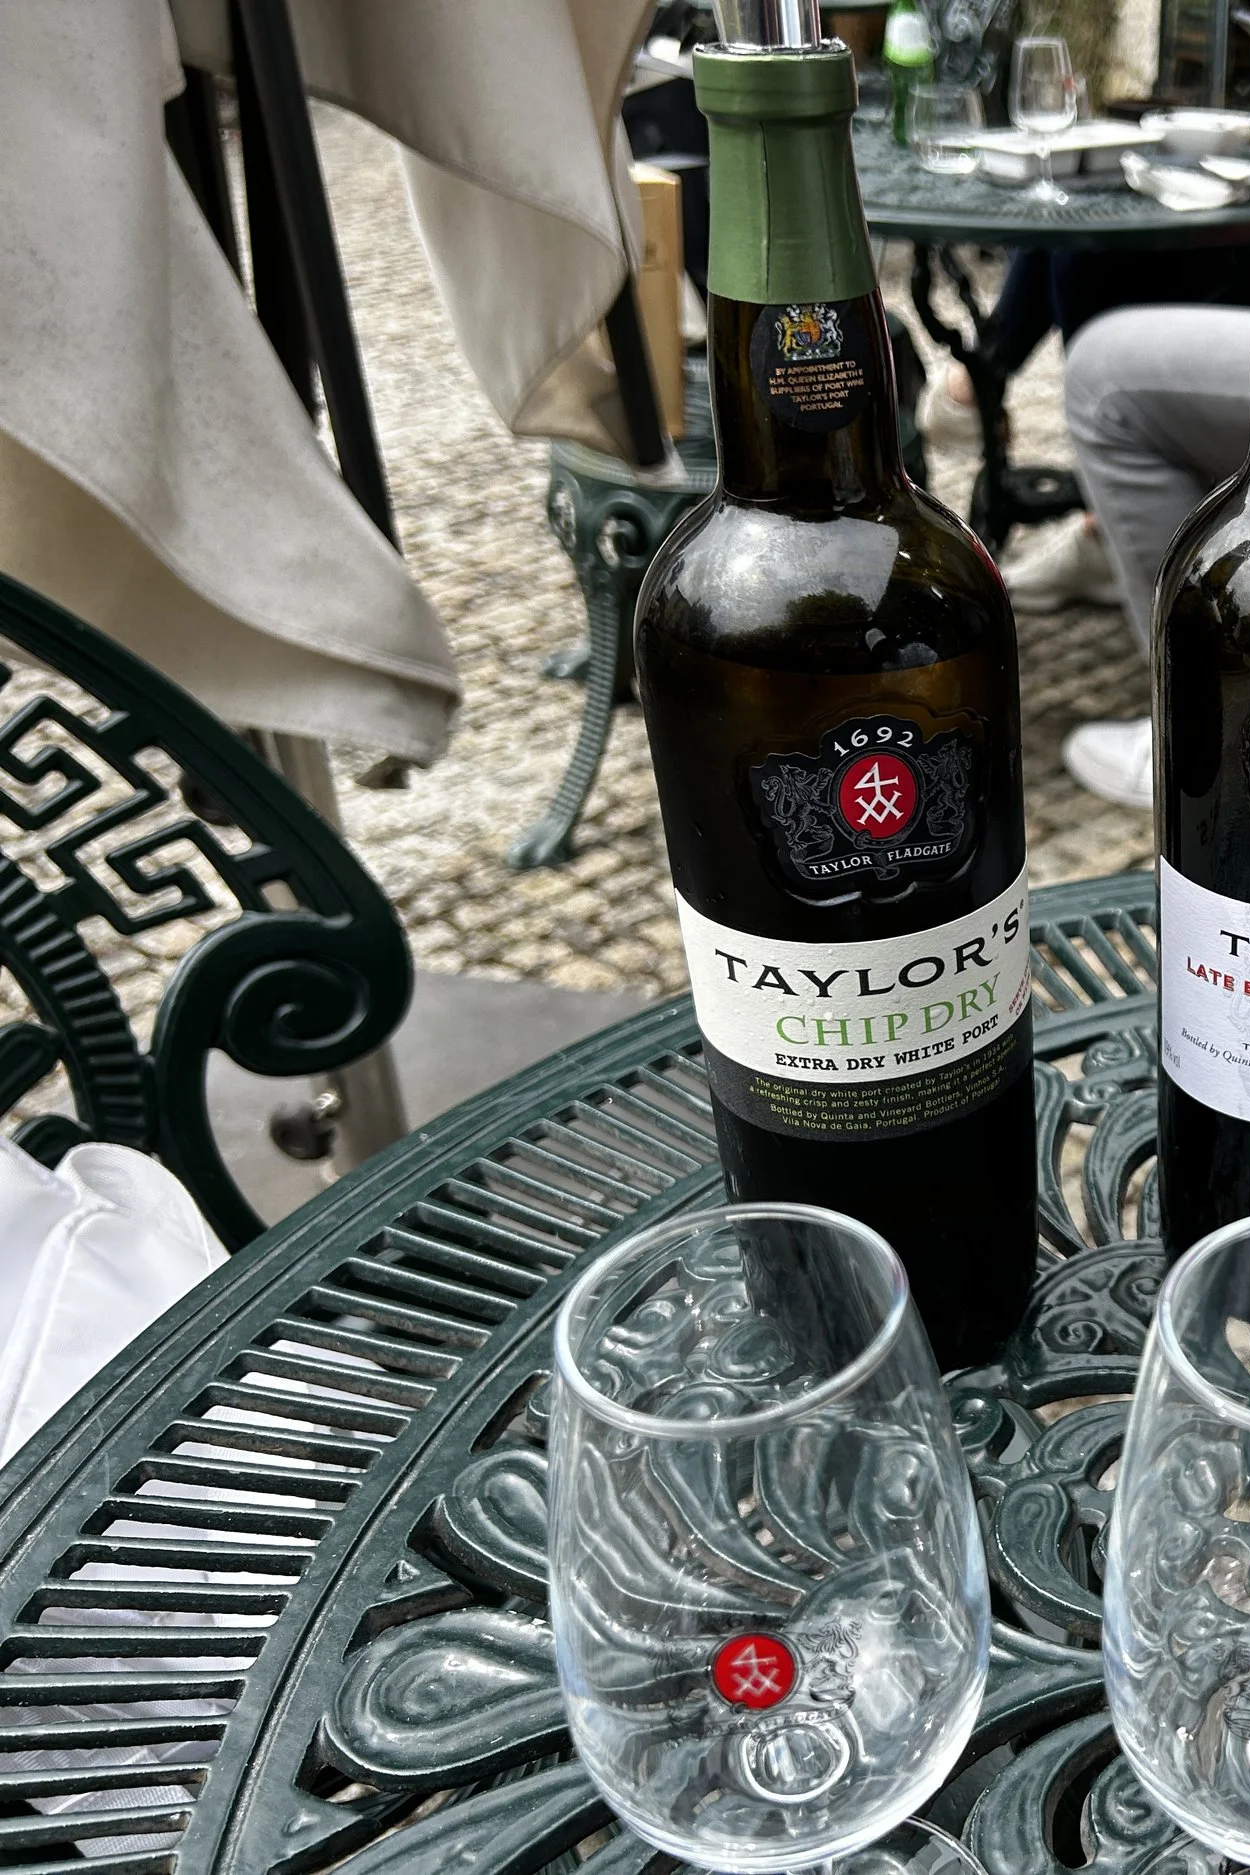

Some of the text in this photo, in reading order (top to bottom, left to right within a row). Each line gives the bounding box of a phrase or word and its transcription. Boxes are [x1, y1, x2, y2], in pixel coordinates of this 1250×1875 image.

[787, 361, 844, 375] APPOINTMENT
[845, 360, 856, 368] TO
[788, 373, 816, 384] QUEEN
[817, 369, 857, 382] ELIZABETH
[792, 390, 849, 403] TAYLOR'S PORT
[812, 383, 823, 391] OF
[824, 381, 845, 390] PORT
[847, 379, 864, 388] WINE
[800, 401, 844, 412] PORTUGAL
[833, 726, 914, 757] 1692
[809, 842, 952, 875] TAYLOR FLADGATE
[714, 908, 1020, 998] TAYLOR'S
[1187, 956, 1235, 992] LATE
[776, 1012, 909, 1047] CHIP
[920, 971, 1001, 1035] DRY
[775, 1014, 999, 1071] EXTRA DRY WHITE PORT
[1181, 1027, 1208, 1050] Bottled
[1209, 1044, 1220, 1058] by
[755, 1077, 770, 1088] The
[773, 1084, 808, 1095] original
[811, 1089, 827, 1098] dry
[830, 1089, 858, 1098] white
[861, 1088, 882, 1099] port
[885, 1080, 922, 1094] created
[925, 1076, 936, 1086] by
[940, 1063, 971, 1080] Taylor's
[757, 1086, 801, 1105] refreshing
[803, 1098, 828, 1108] crisp
[853, 1098, 879, 1108] zesty
[918, 1081, 951, 1097] making
[953, 1077, 961, 1086] it
[770, 1103, 803, 1117] Bottled
[806, 1111, 817, 1120] by
[821, 1111, 854, 1120] Quinta
[858, 1111, 876, 1119] and
[880, 1103, 922, 1118] Vineyard
[965, 1075, 990, 1093] Vinhos
[782, 1116, 800, 1126] Vila
[803, 1120, 827, 1130] Nova
[830, 1121, 842, 1130] de
[924, 1102, 959, 1118] Product
[961, 1095, 970, 1105] of
